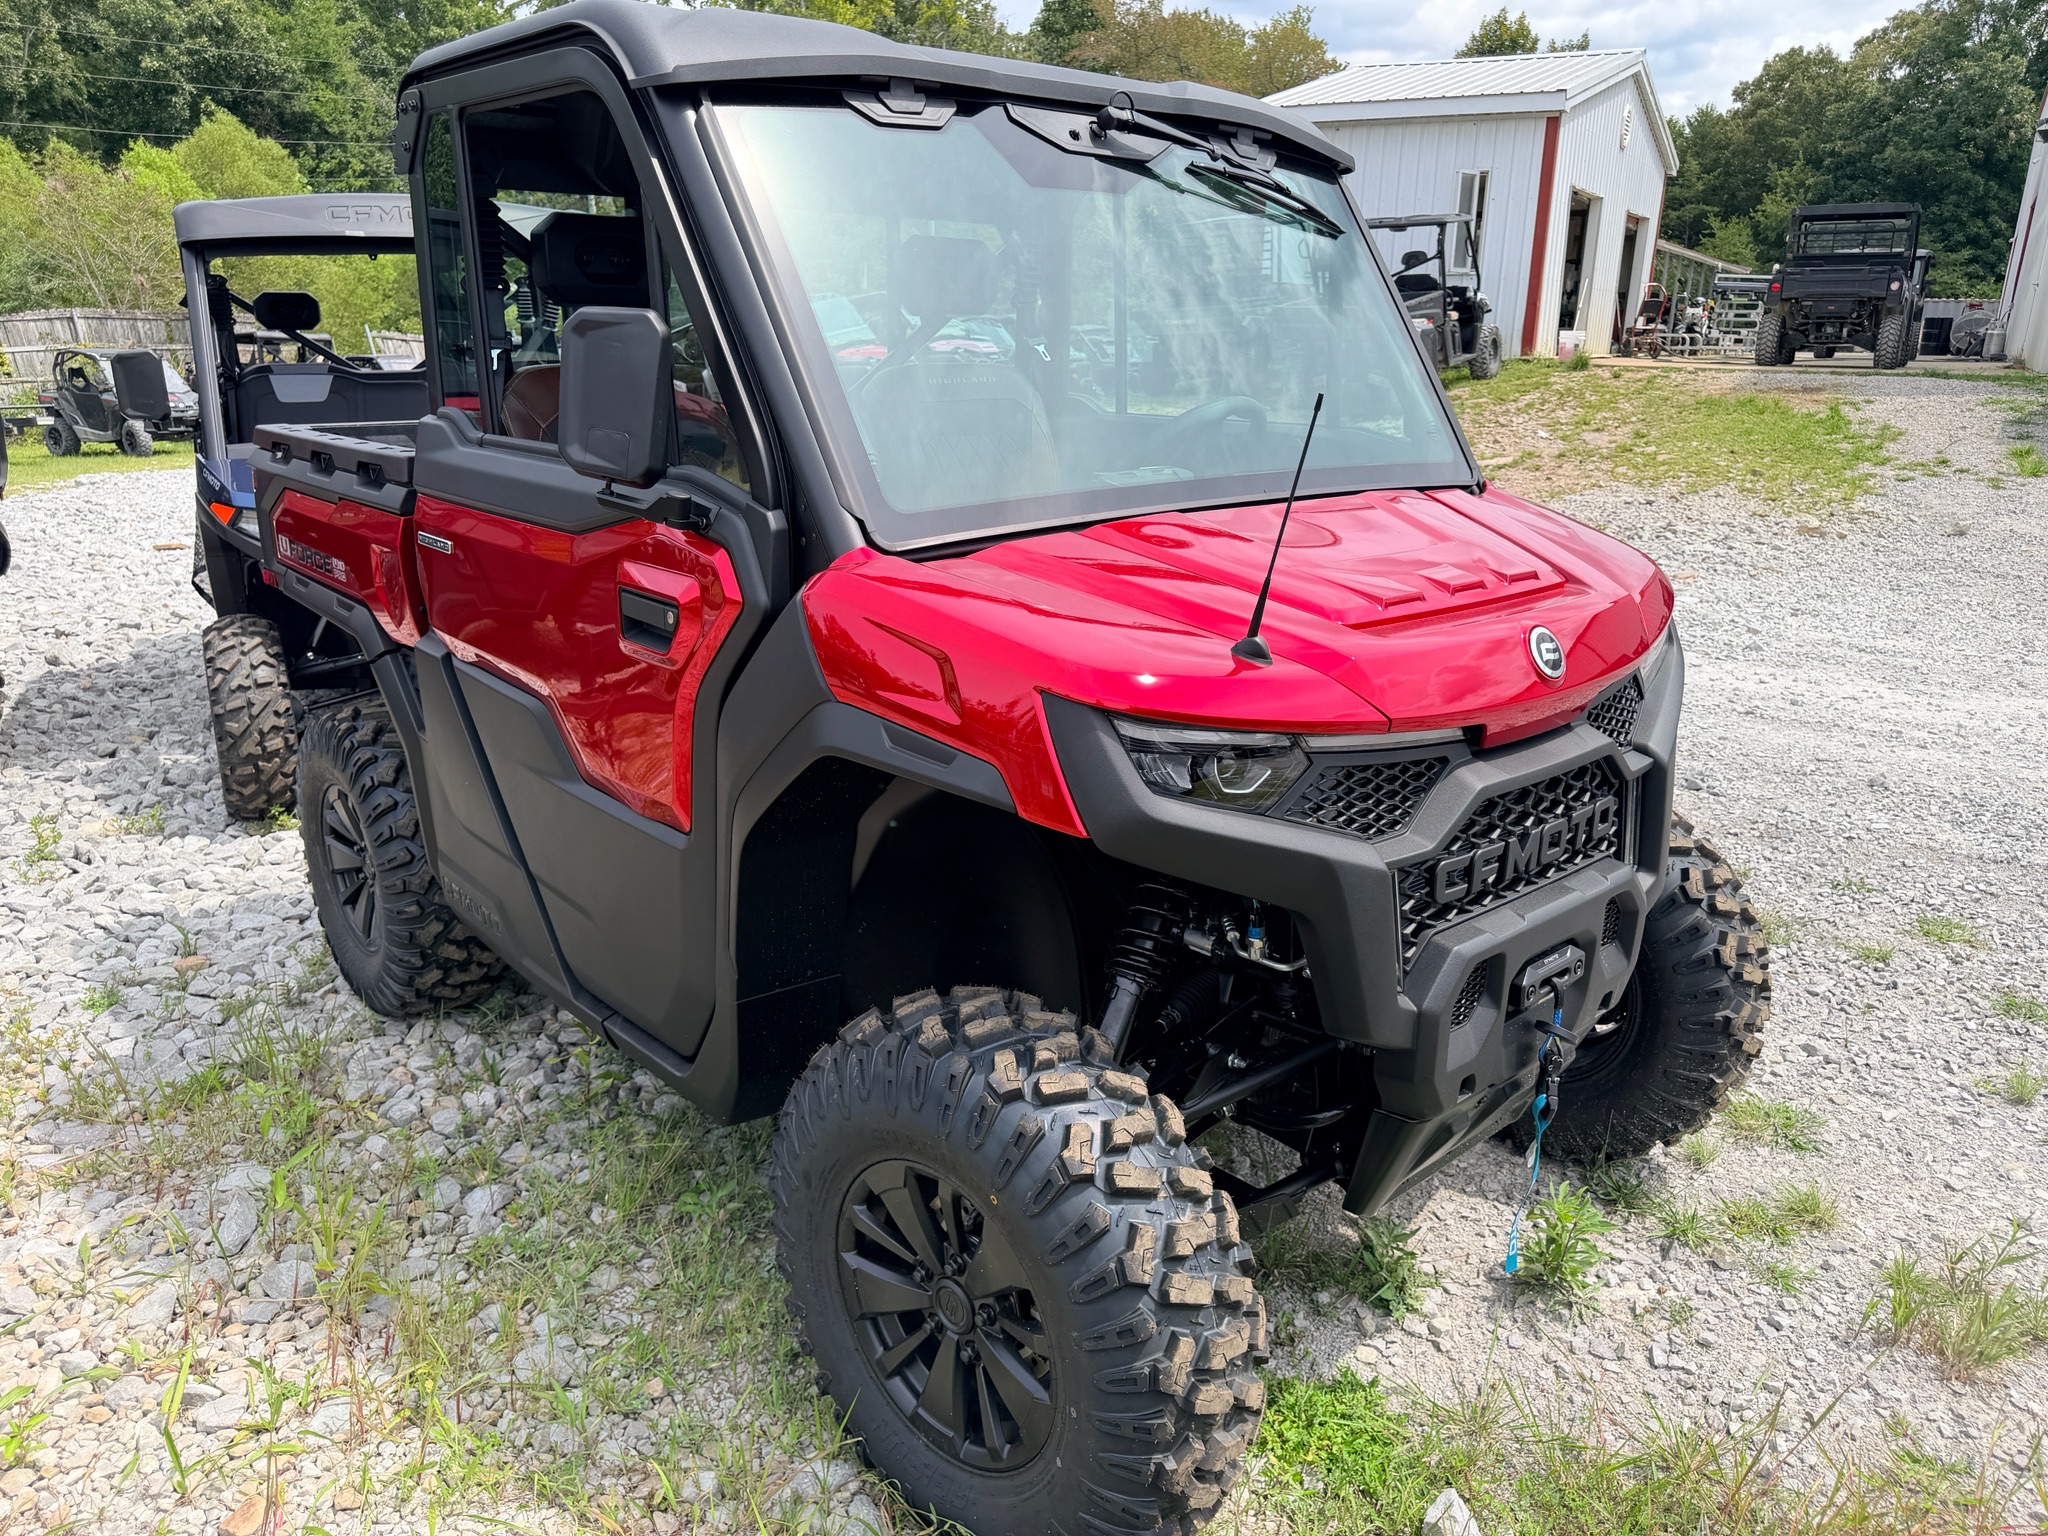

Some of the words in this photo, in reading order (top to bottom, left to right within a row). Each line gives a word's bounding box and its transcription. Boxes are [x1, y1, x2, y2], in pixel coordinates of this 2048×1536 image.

[929, 376, 996, 385] HIGHLAND
[202, 468, 221, 491] CFMOTO
[1435, 795, 1615, 904] CFMOTO
